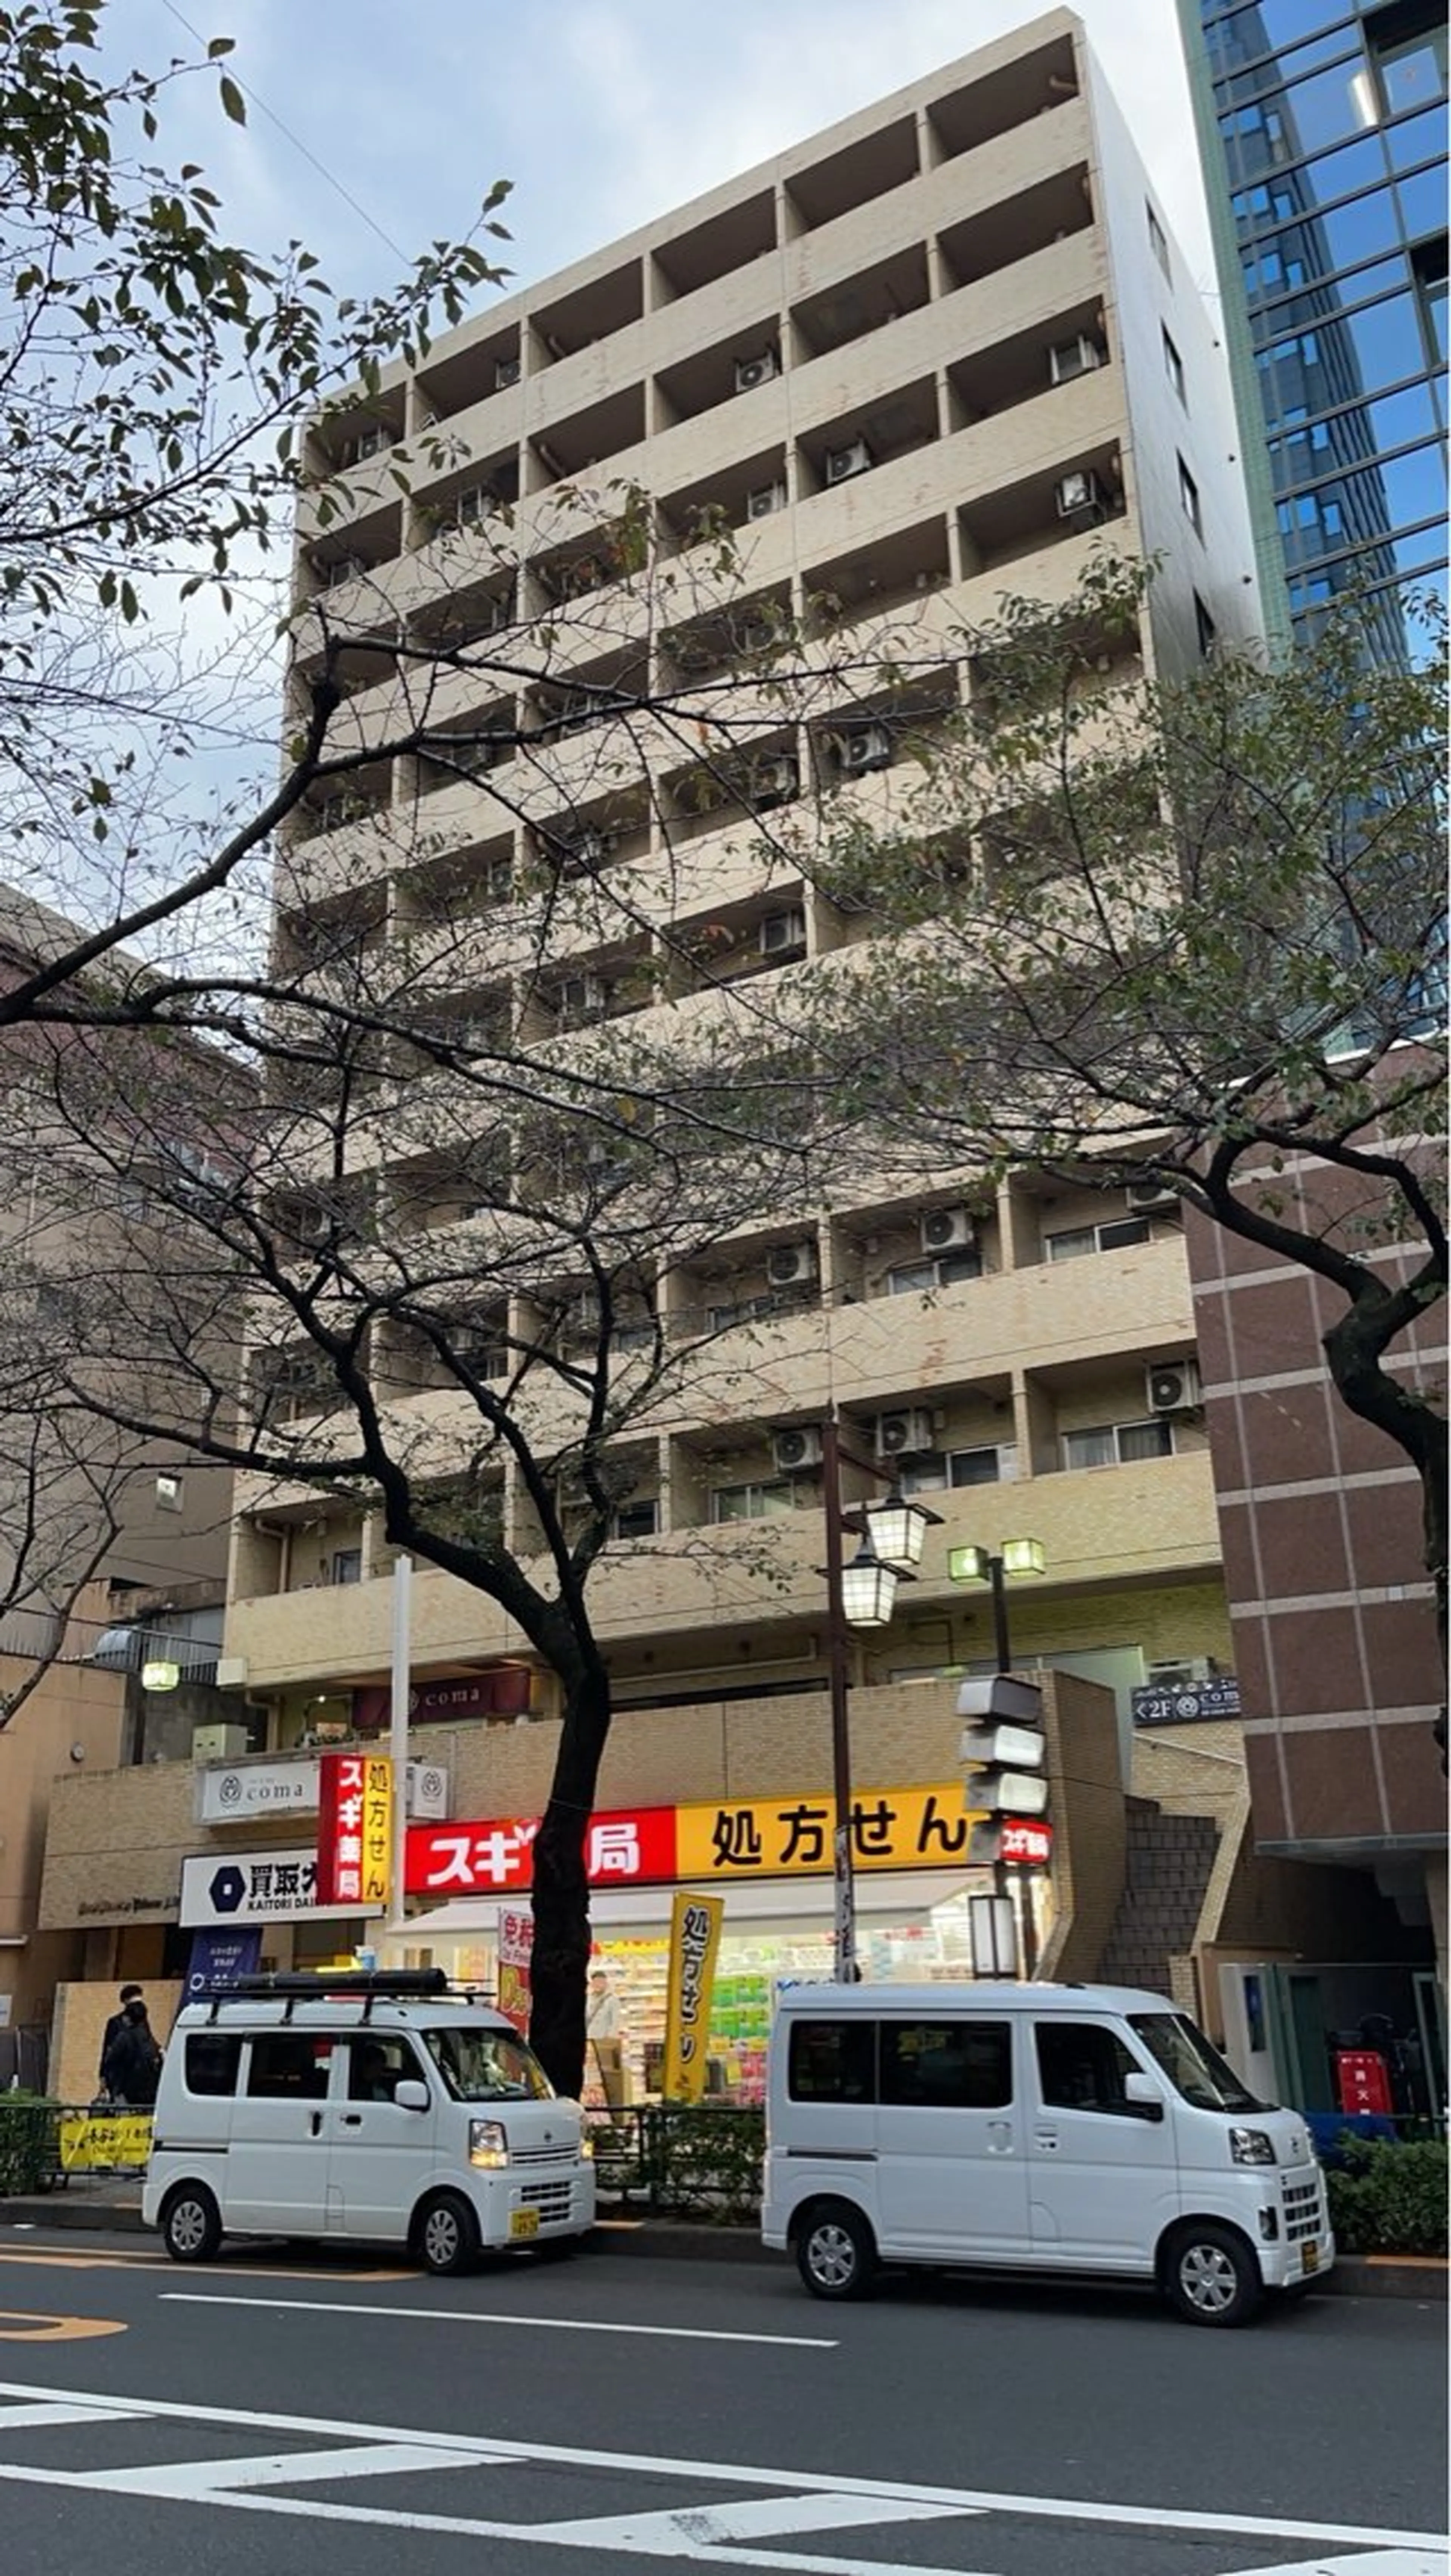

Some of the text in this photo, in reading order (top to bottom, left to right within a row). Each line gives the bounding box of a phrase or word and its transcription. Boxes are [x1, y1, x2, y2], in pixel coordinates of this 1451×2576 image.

[425, 1687, 480, 1706] coma
[1149, 1700, 1170, 1718] 2F
[247, 1783, 303, 1801] coma
[339, 1760, 363, 1899] スギ薬局
[367, 1762, 388, 1898] 処方せん
[712, 1796, 968, 1867] 処方せん
[427, 1823, 641, 1886] スギ局
[248, 1898, 292, 1911] KAITORI
